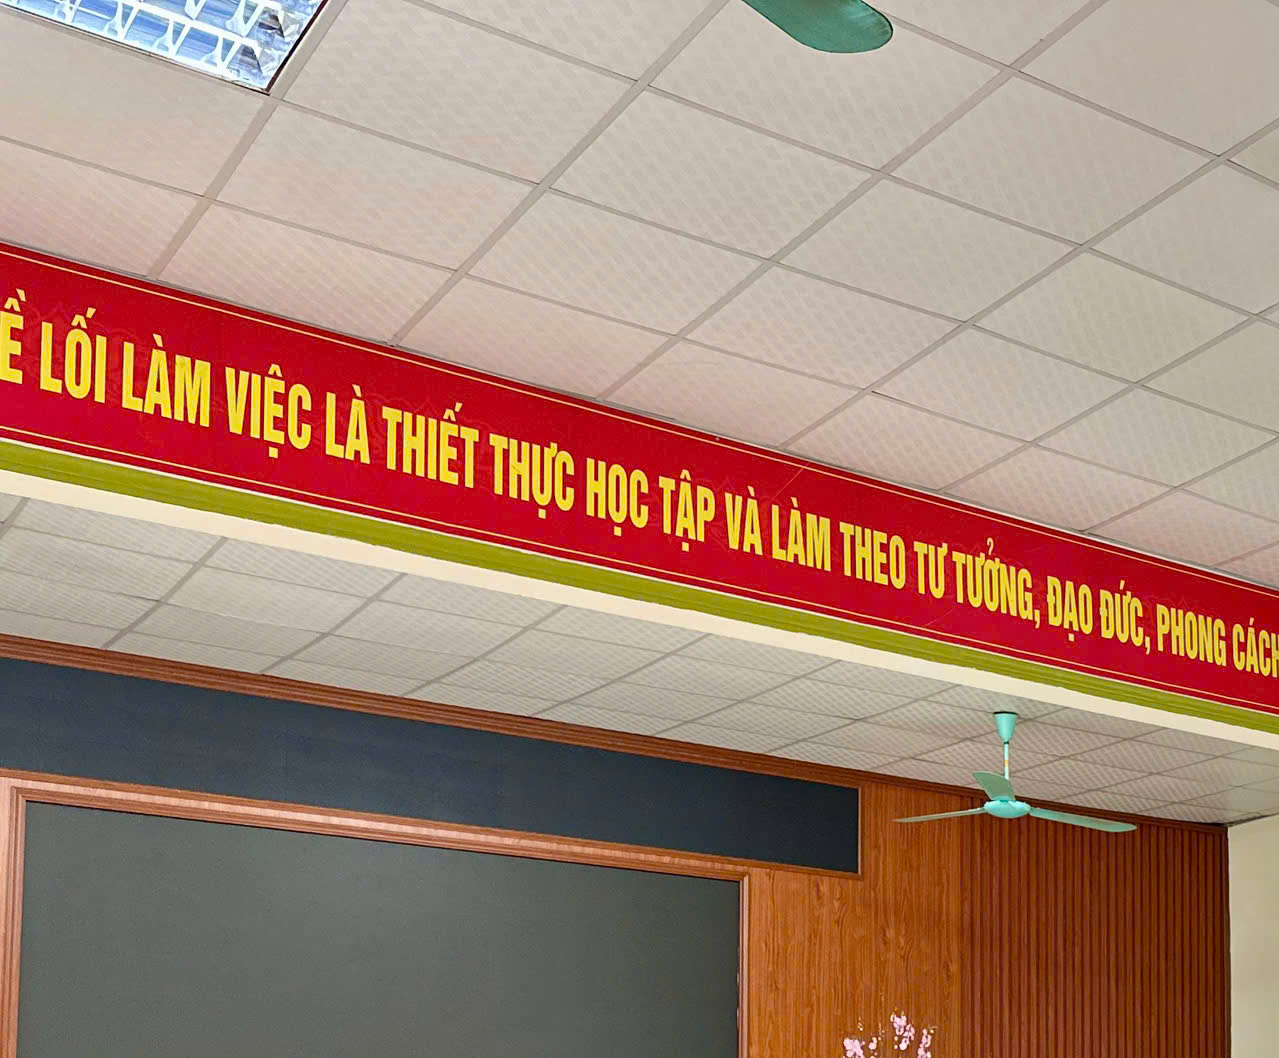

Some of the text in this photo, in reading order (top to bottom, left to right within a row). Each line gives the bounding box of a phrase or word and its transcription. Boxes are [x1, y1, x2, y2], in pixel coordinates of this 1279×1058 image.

[40, 306, 107, 404] LỐI
[122, 334, 211, 428] LÀM
[225, 364, 312, 459] VIỆC
[325, 384, 370, 465] LÀ
[382, 403, 479, 489] THIẾT
[489, 433, 575, 519] THỰC
[586, 458, 649, 537] HỌC
[659, 468, 716, 552] TẬP
[725, 486, 763, 556] VÀ
[772, 497, 831, 572] LÀM
[839, 521, 906, 590] THEO
[913, 541, 948, 599] TƯ
[952, 537, 1040, 629] TƯỞNG,
[1046, 576, 1093, 642] ĐẠO
[1099, 579, 1151, 654] ĐỨC,
[1156, 604, 1227, 668] PHONG
